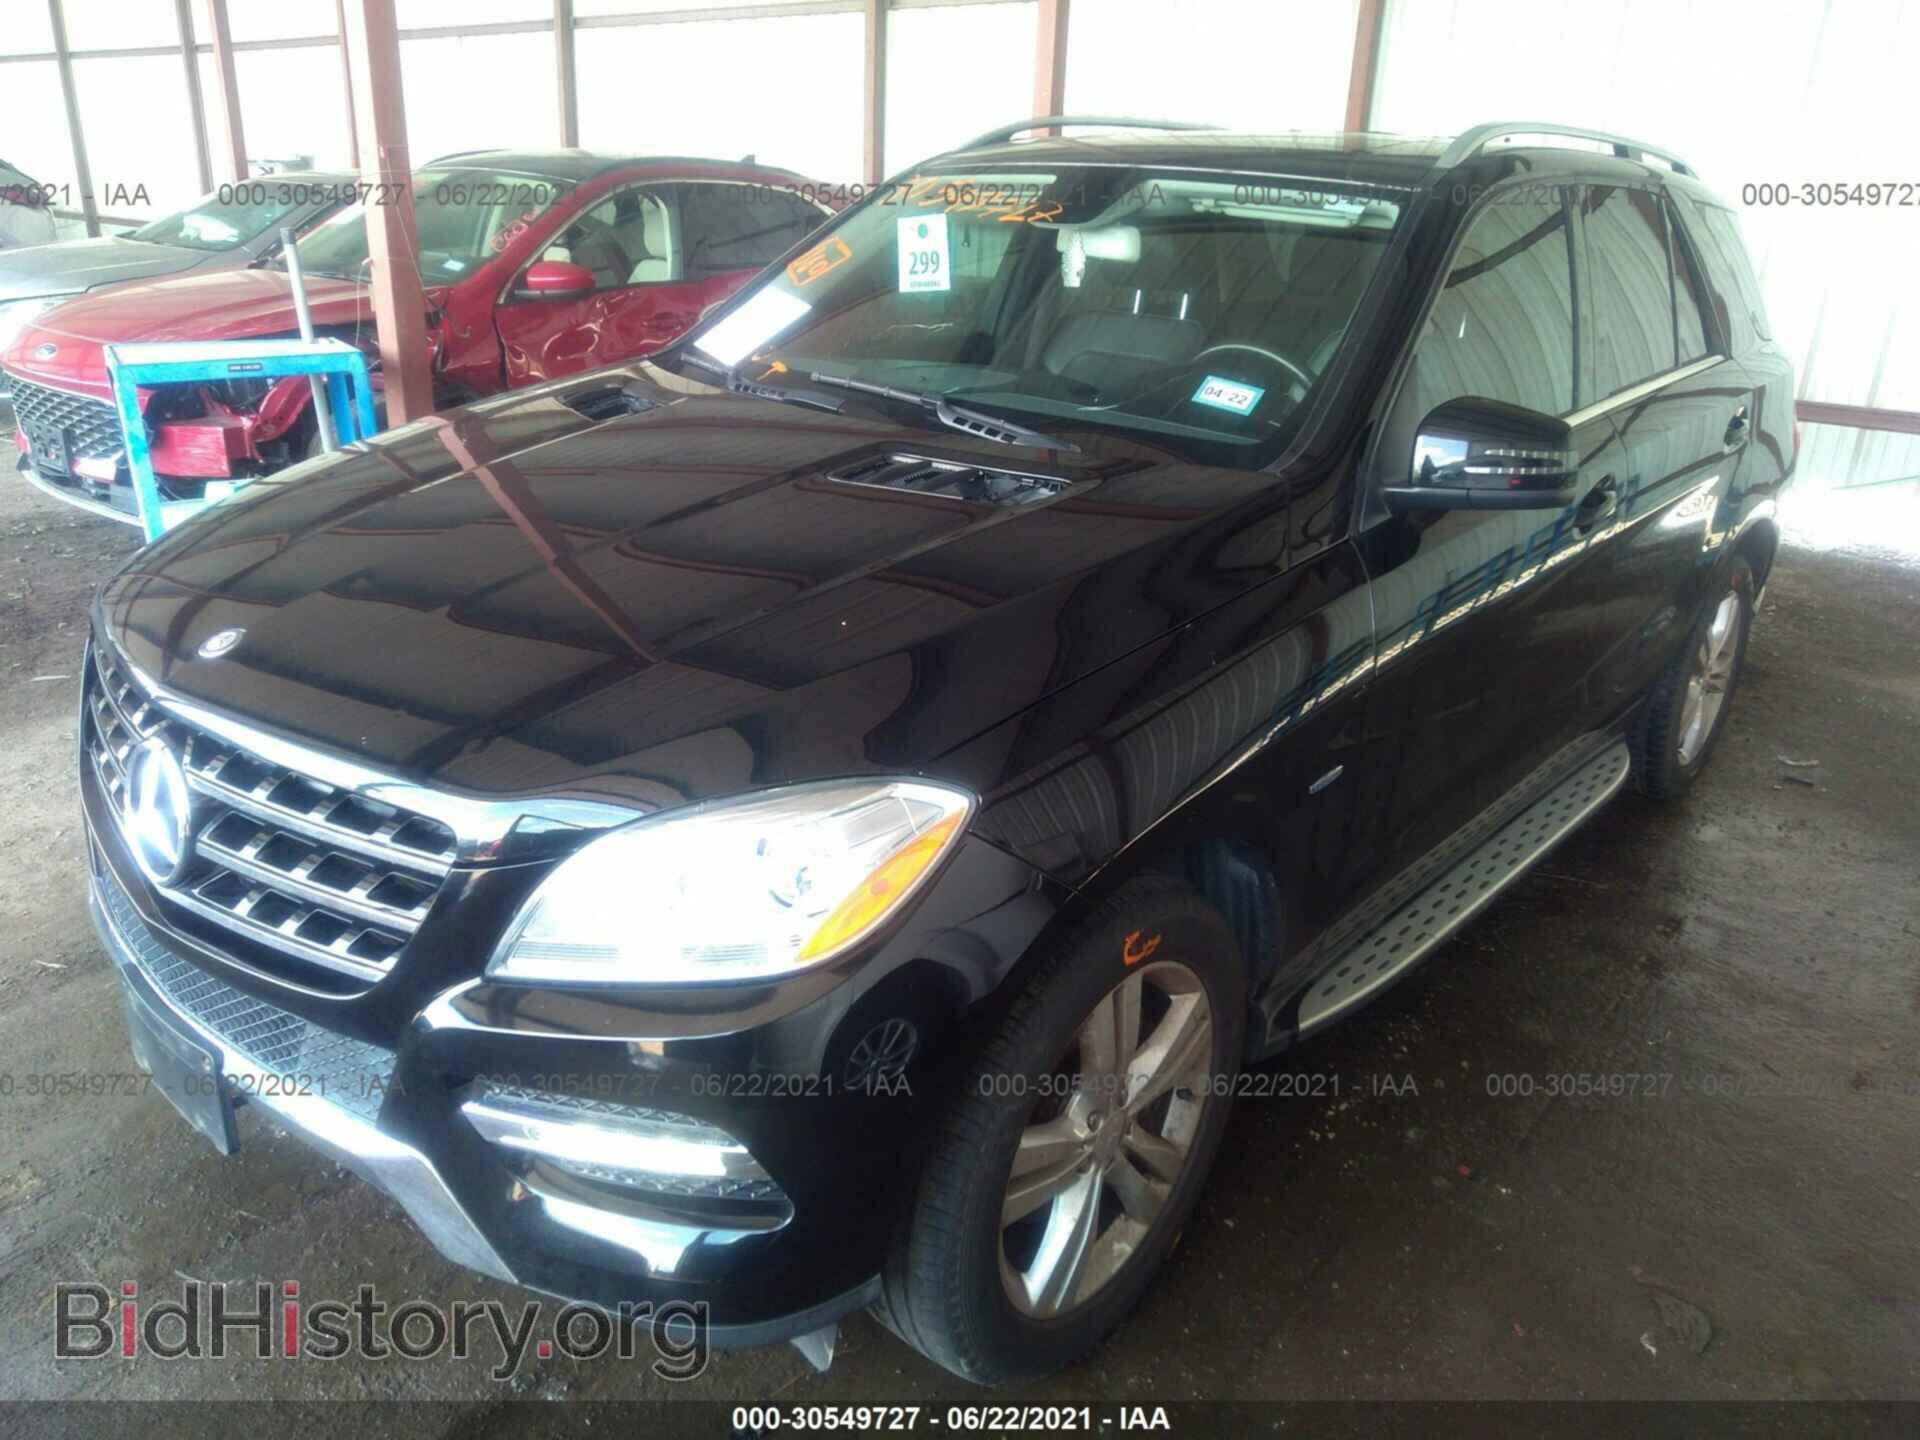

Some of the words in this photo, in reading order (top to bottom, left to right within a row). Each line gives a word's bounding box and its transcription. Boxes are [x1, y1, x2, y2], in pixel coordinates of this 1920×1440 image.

[909, 251, 940, 275] 299
[1204, 386, 1223, 398] 04
[1228, 392, 1248, 405] 22
